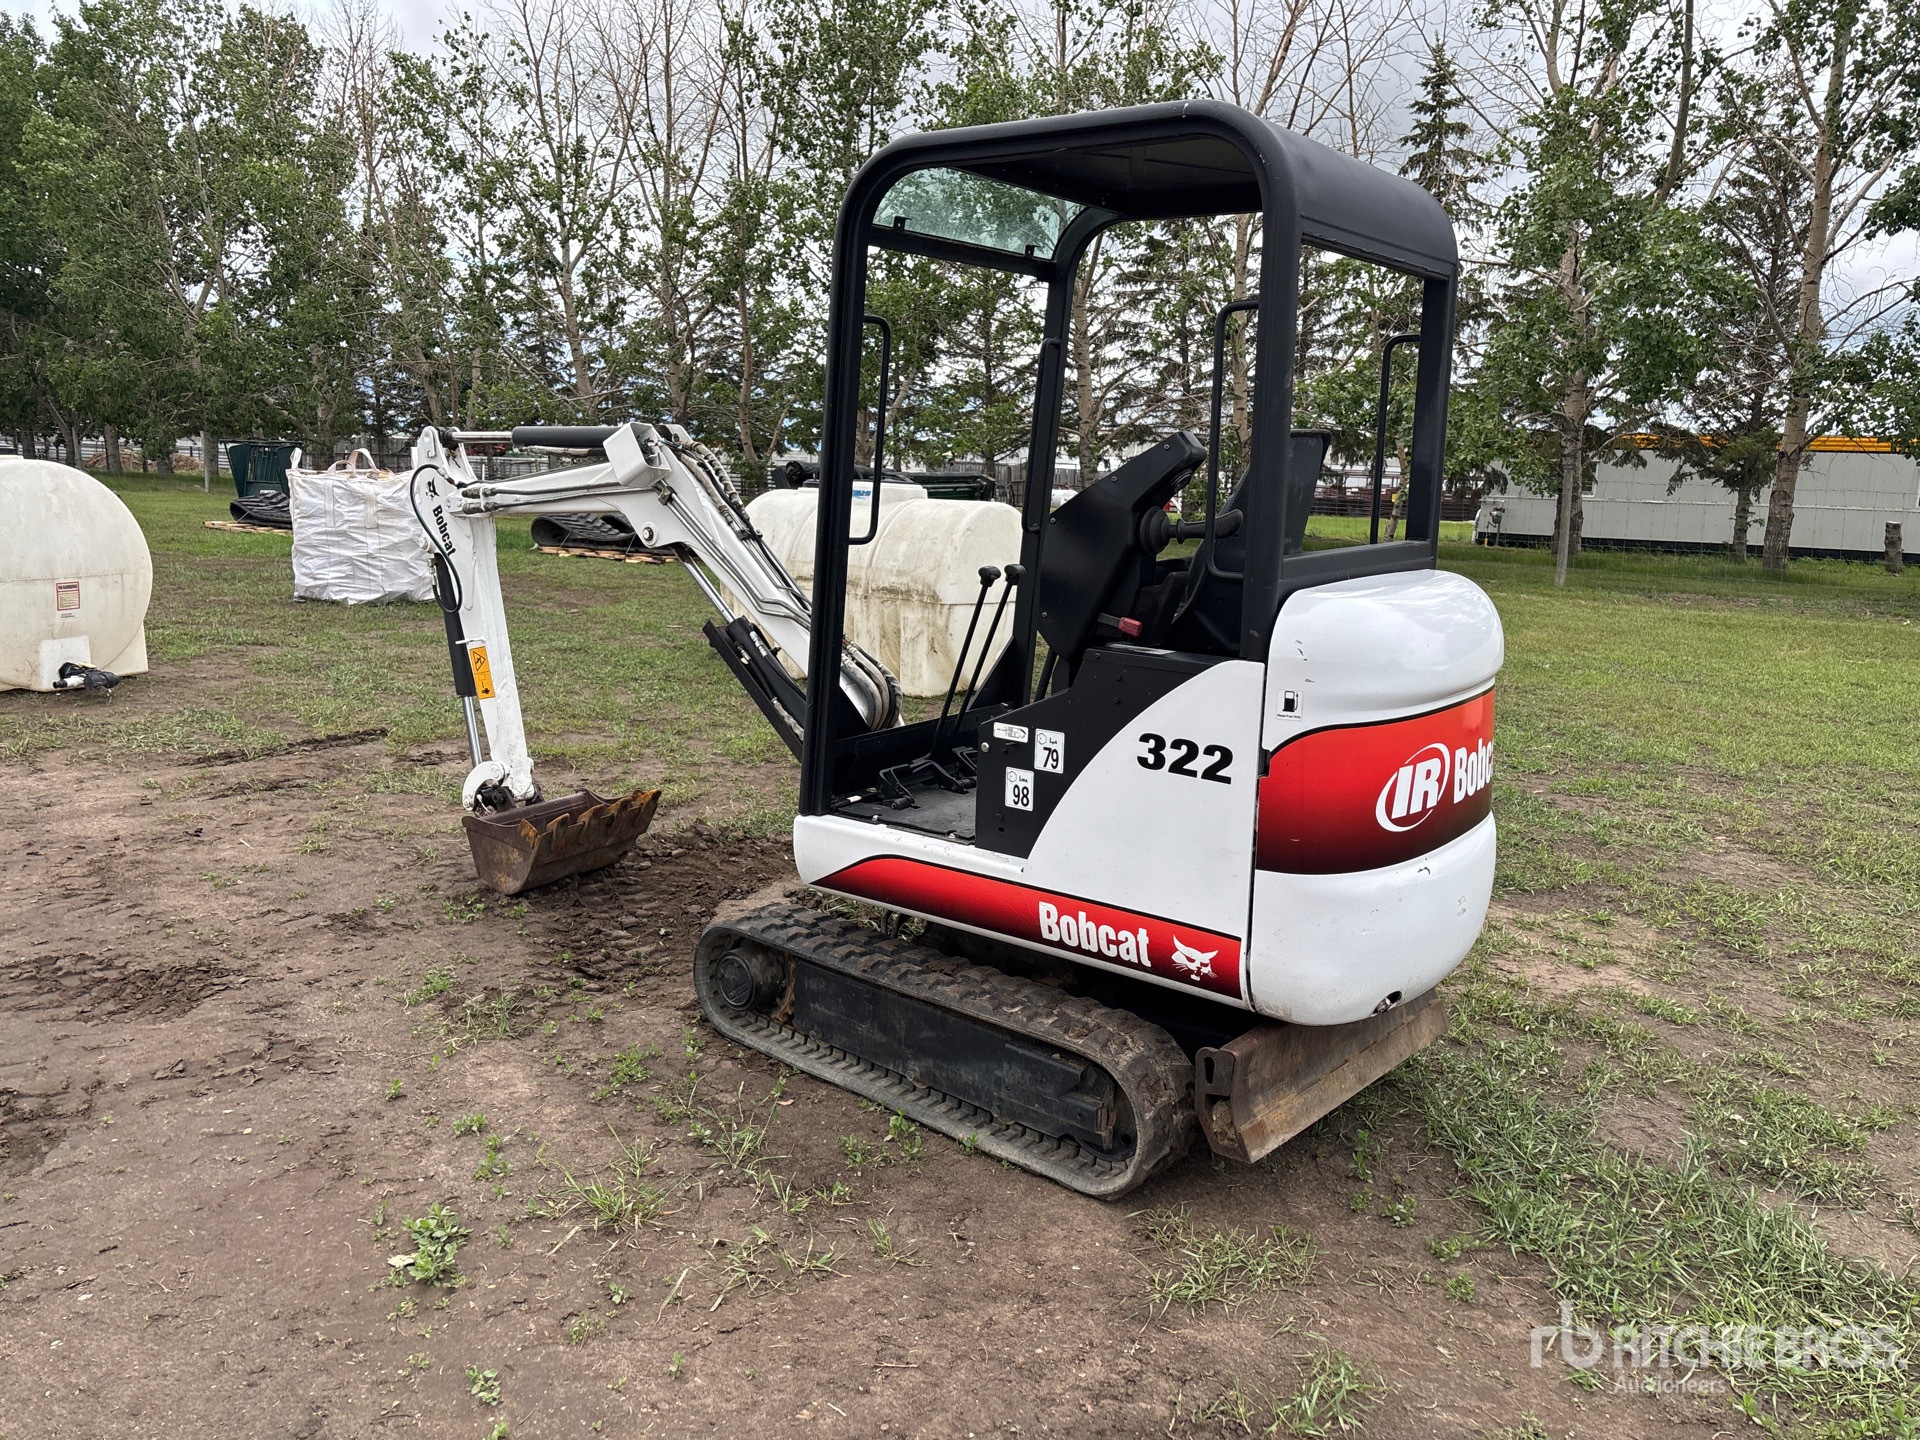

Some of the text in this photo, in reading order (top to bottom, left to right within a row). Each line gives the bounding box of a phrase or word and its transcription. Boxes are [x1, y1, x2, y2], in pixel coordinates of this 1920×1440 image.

[432, 504, 457, 557] Bobcat
[1042, 746, 1059, 770] 79
[1136, 733, 1234, 785] 322
[1391, 737, 1494, 820] IR Bobc
[1012, 784, 1030, 807] 98
[1038, 900, 1152, 968] Bobcat
